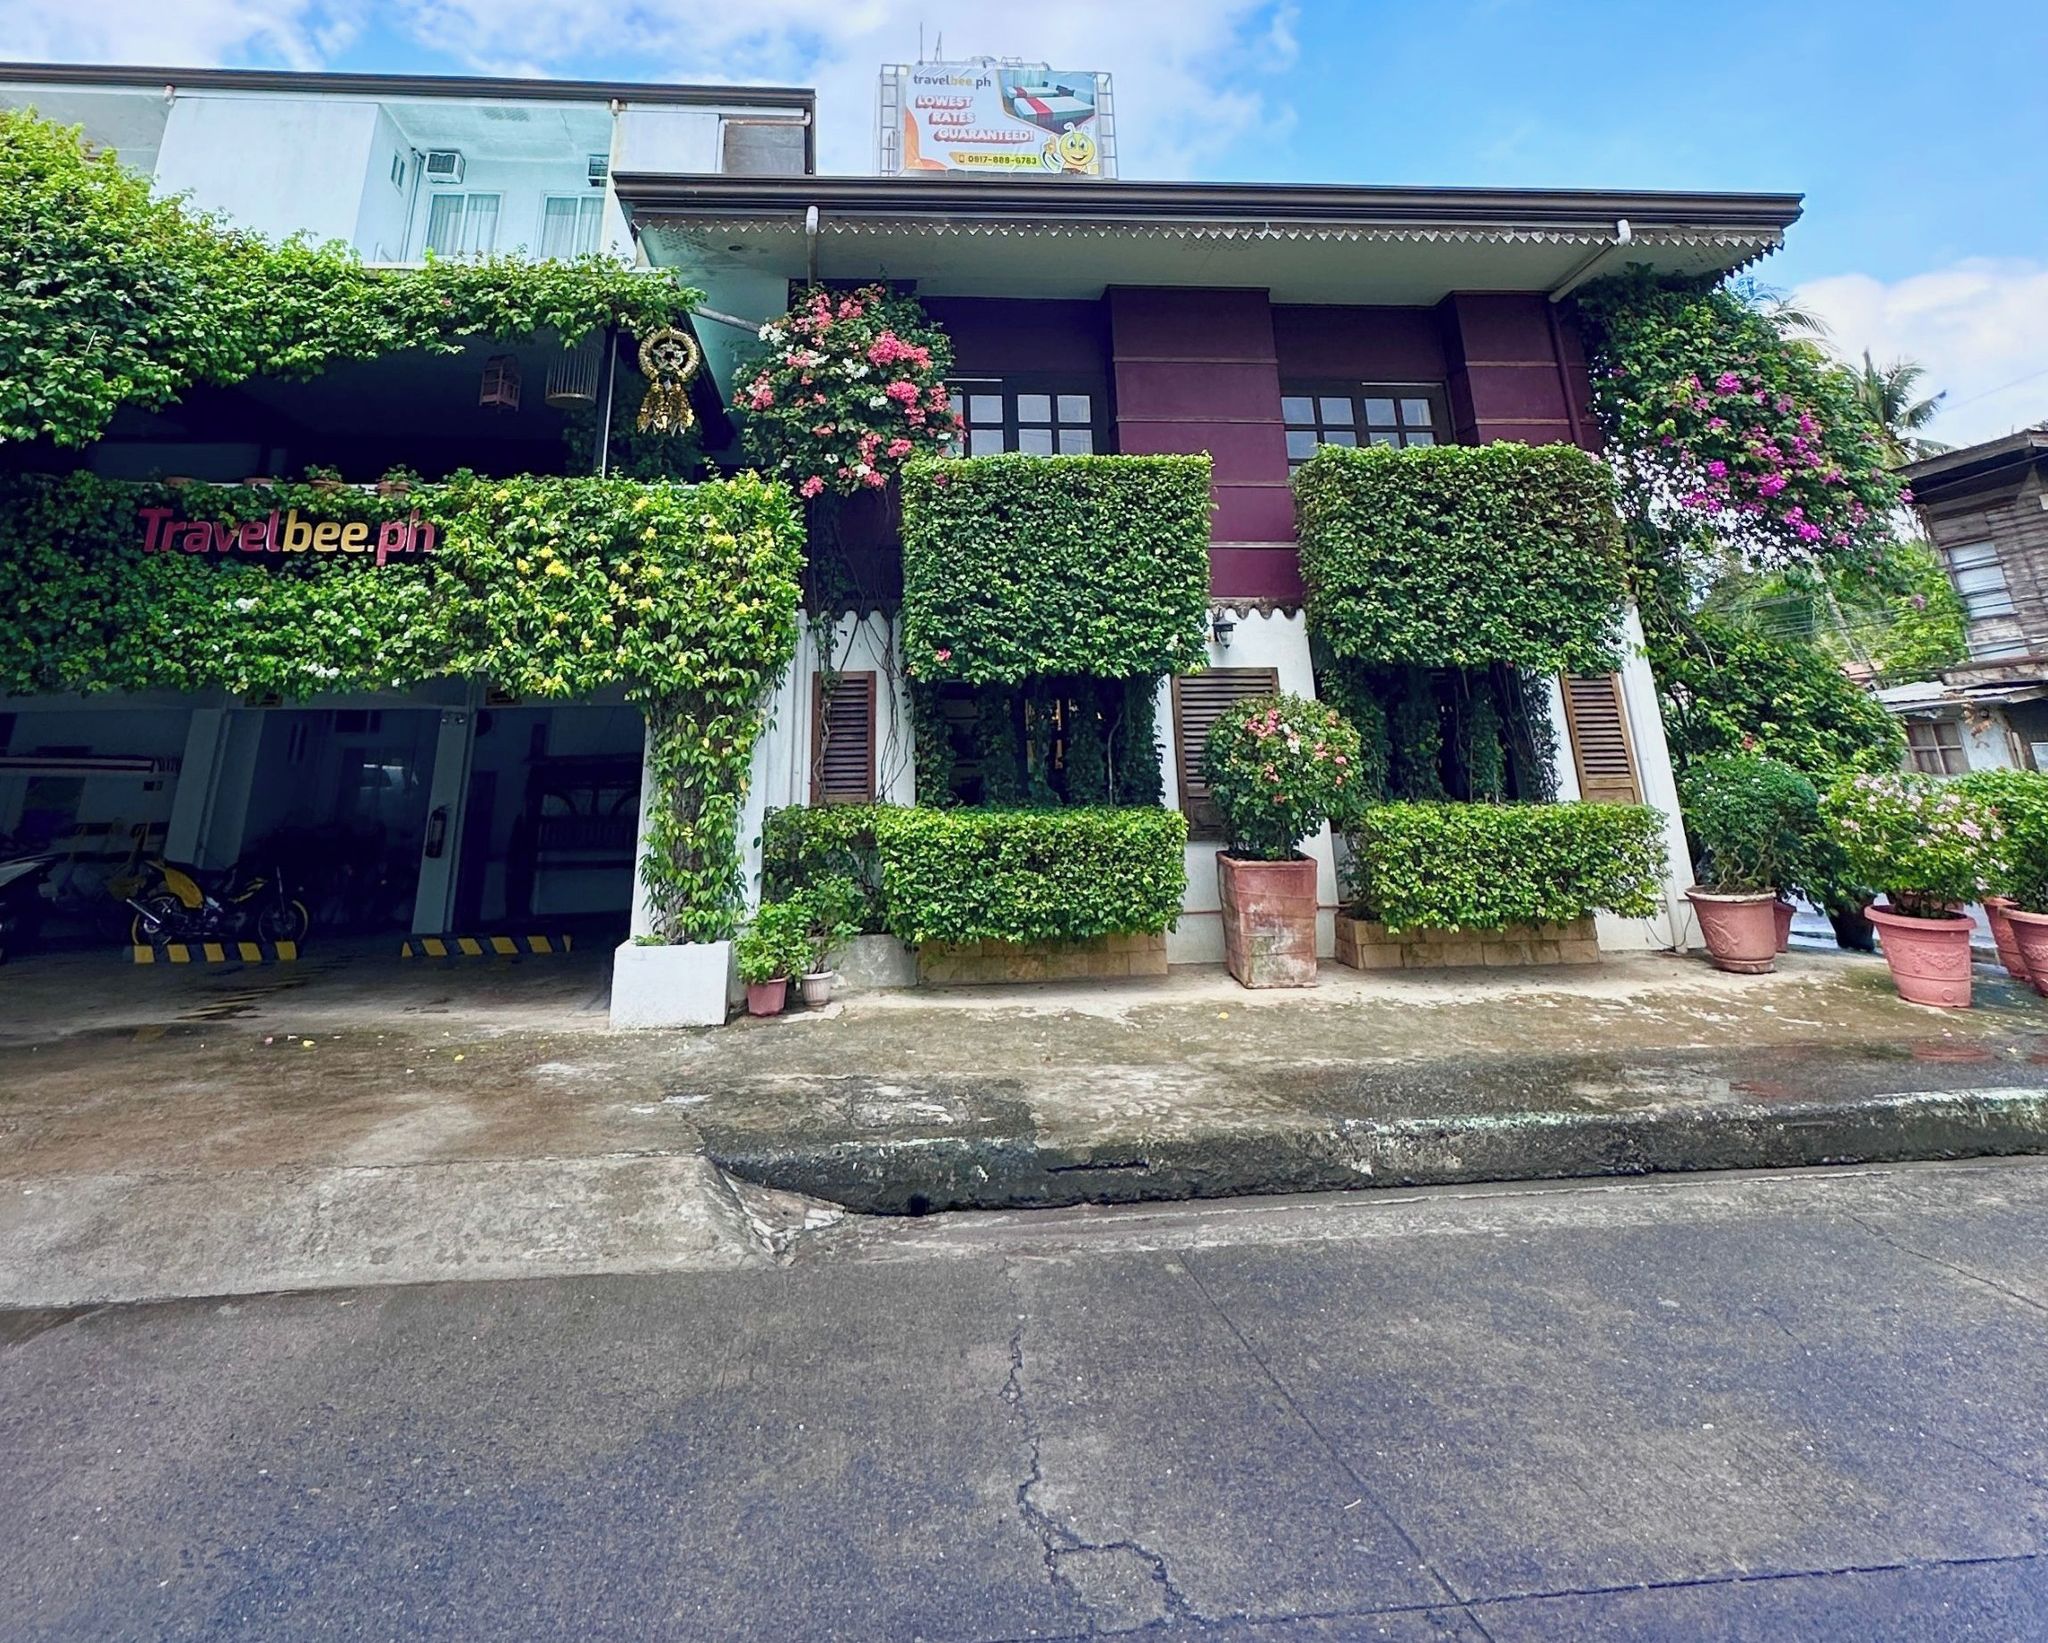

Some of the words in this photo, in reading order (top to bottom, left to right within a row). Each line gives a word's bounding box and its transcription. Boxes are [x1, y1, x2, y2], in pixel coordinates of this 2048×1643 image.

[916, 95, 973, 109] LOWEST
[929, 112, 976, 125] RATES
[934, 129, 1034, 143] GUARANTEED!
[139, 507, 436, 567] Travelbee.ph
